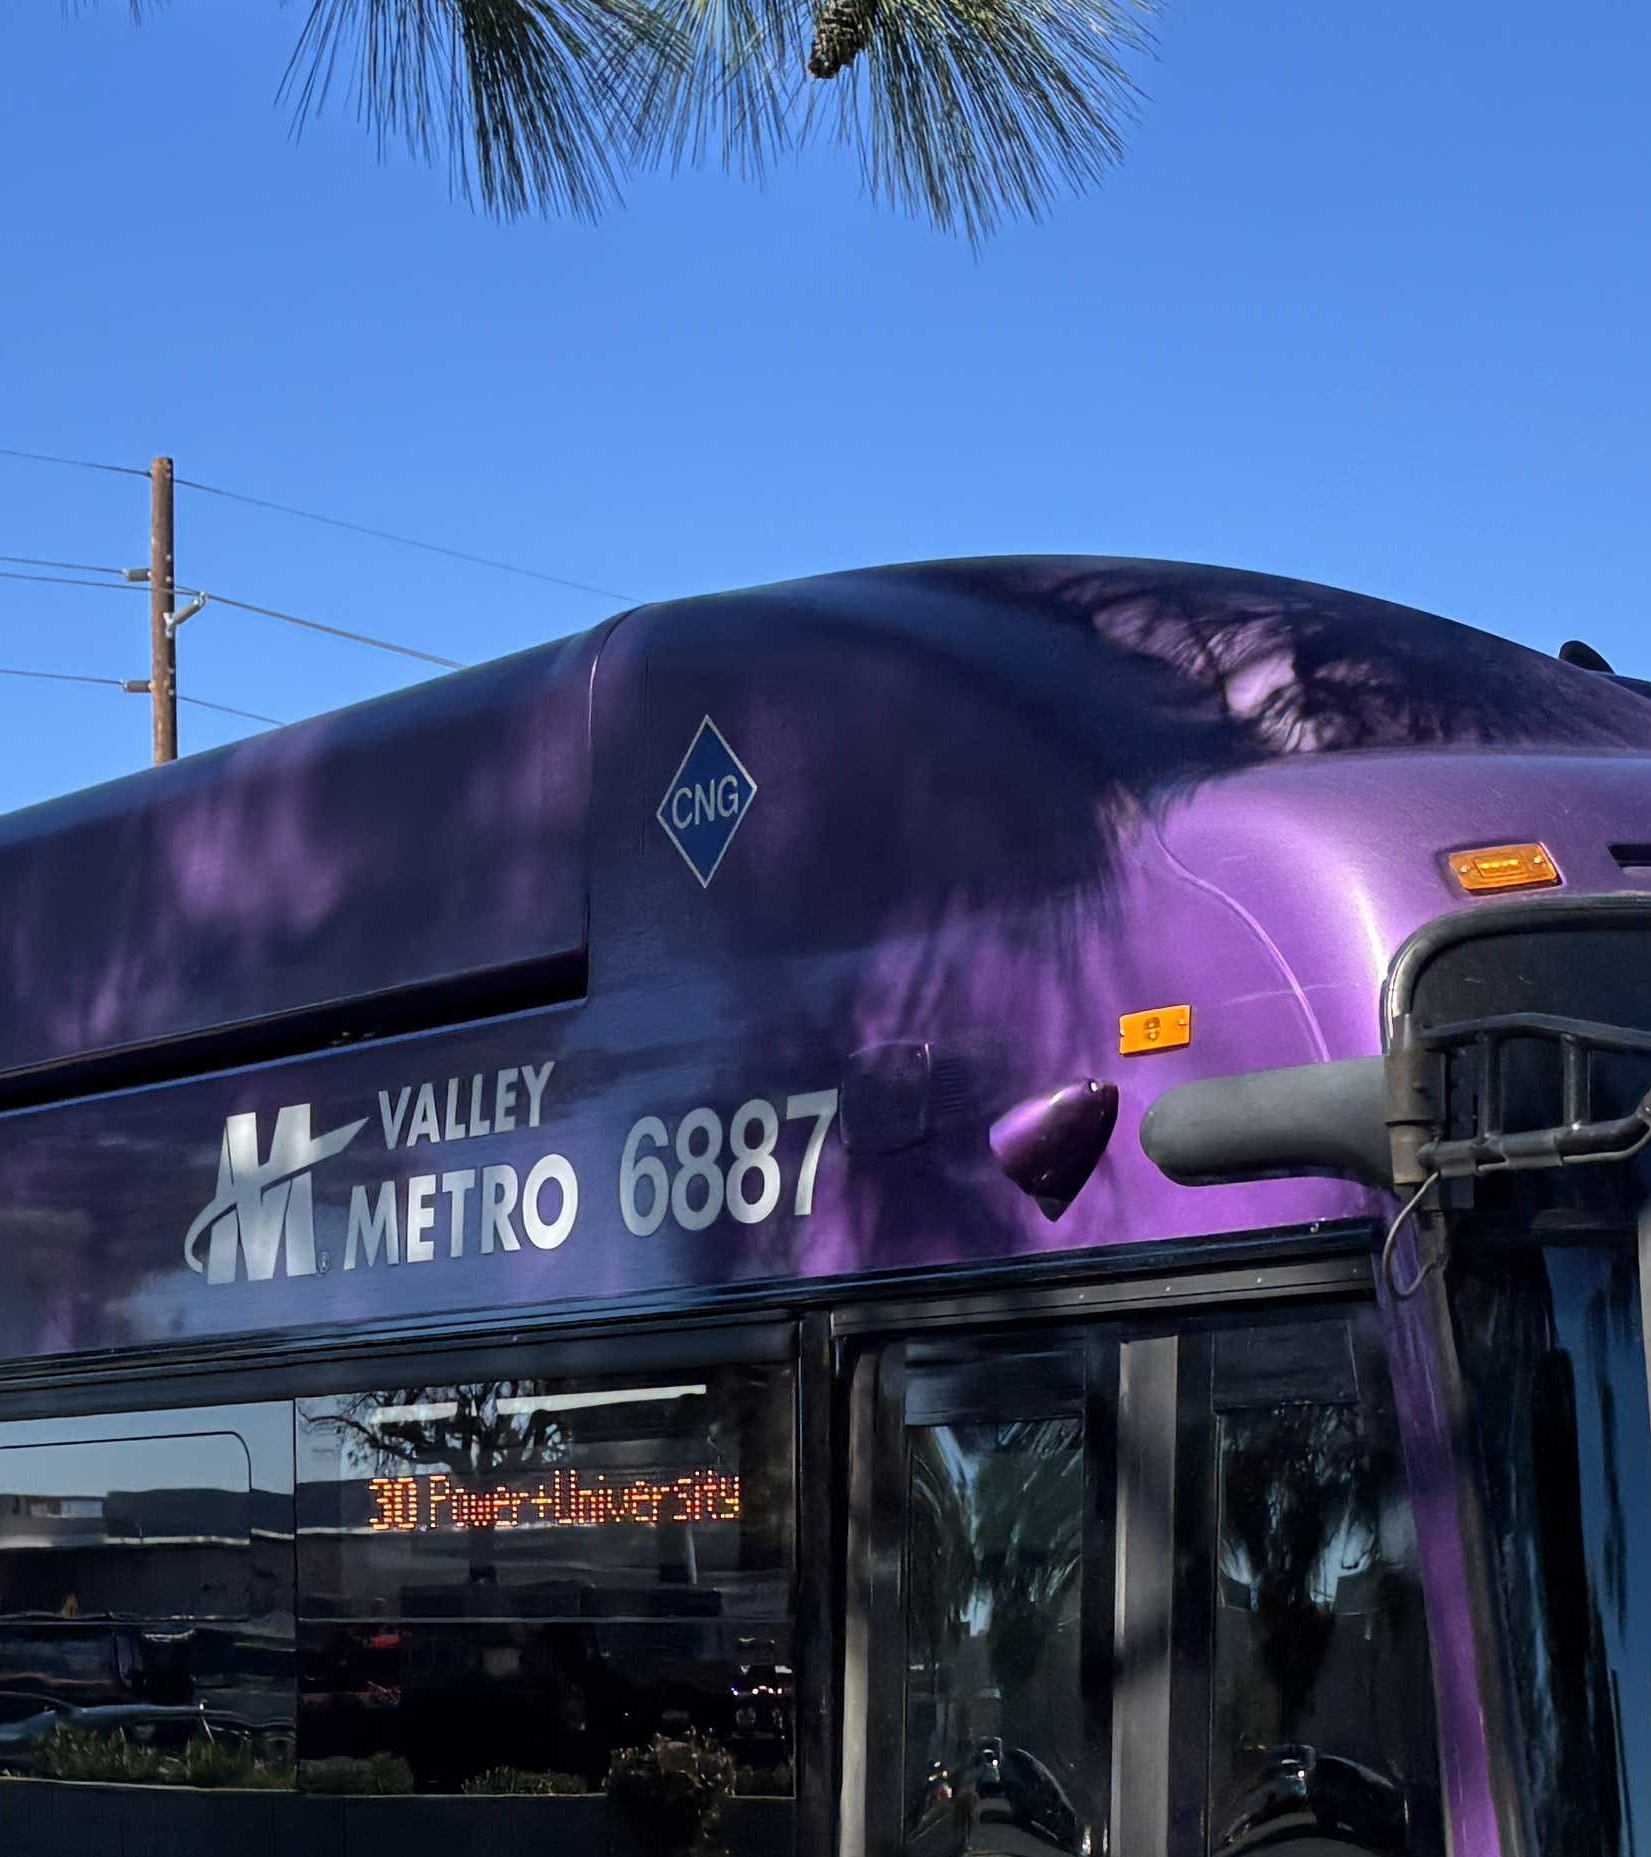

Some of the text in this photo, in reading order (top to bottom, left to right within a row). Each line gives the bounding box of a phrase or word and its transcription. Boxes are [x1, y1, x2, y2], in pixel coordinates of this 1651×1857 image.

[670, 774, 740, 830] CNG
[378, 1061, 556, 1150] VALLEY
[618, 1088, 839, 1238] 6887
[343, 1153, 580, 1271] METRO
[369, 1477, 418, 1530] 30
